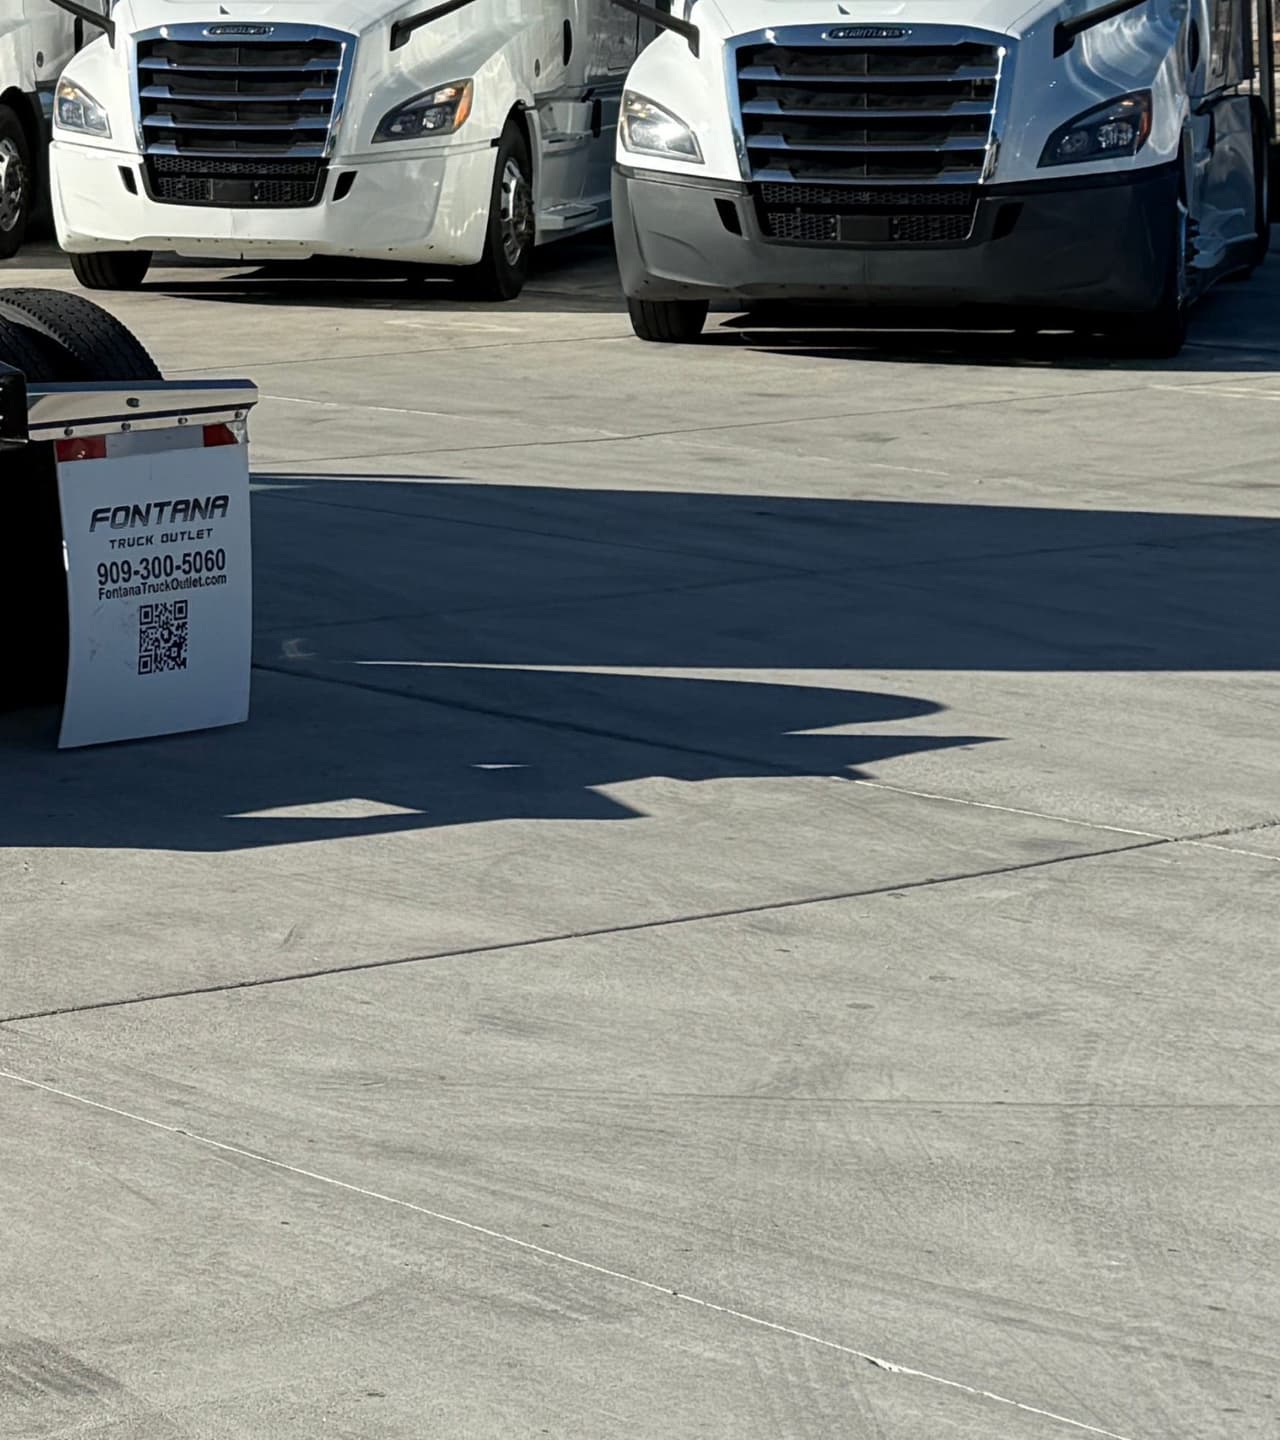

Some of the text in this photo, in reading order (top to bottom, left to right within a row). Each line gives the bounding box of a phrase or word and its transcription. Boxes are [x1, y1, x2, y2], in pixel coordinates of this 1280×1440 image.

[89, 495, 229, 532] FONTANA
[109, 528, 214, 549] TRUCK OUTLET
[97, 548, 226, 586] 909-300-5060
[98, 574, 227, 600] FontanaTruckOutlet.com
